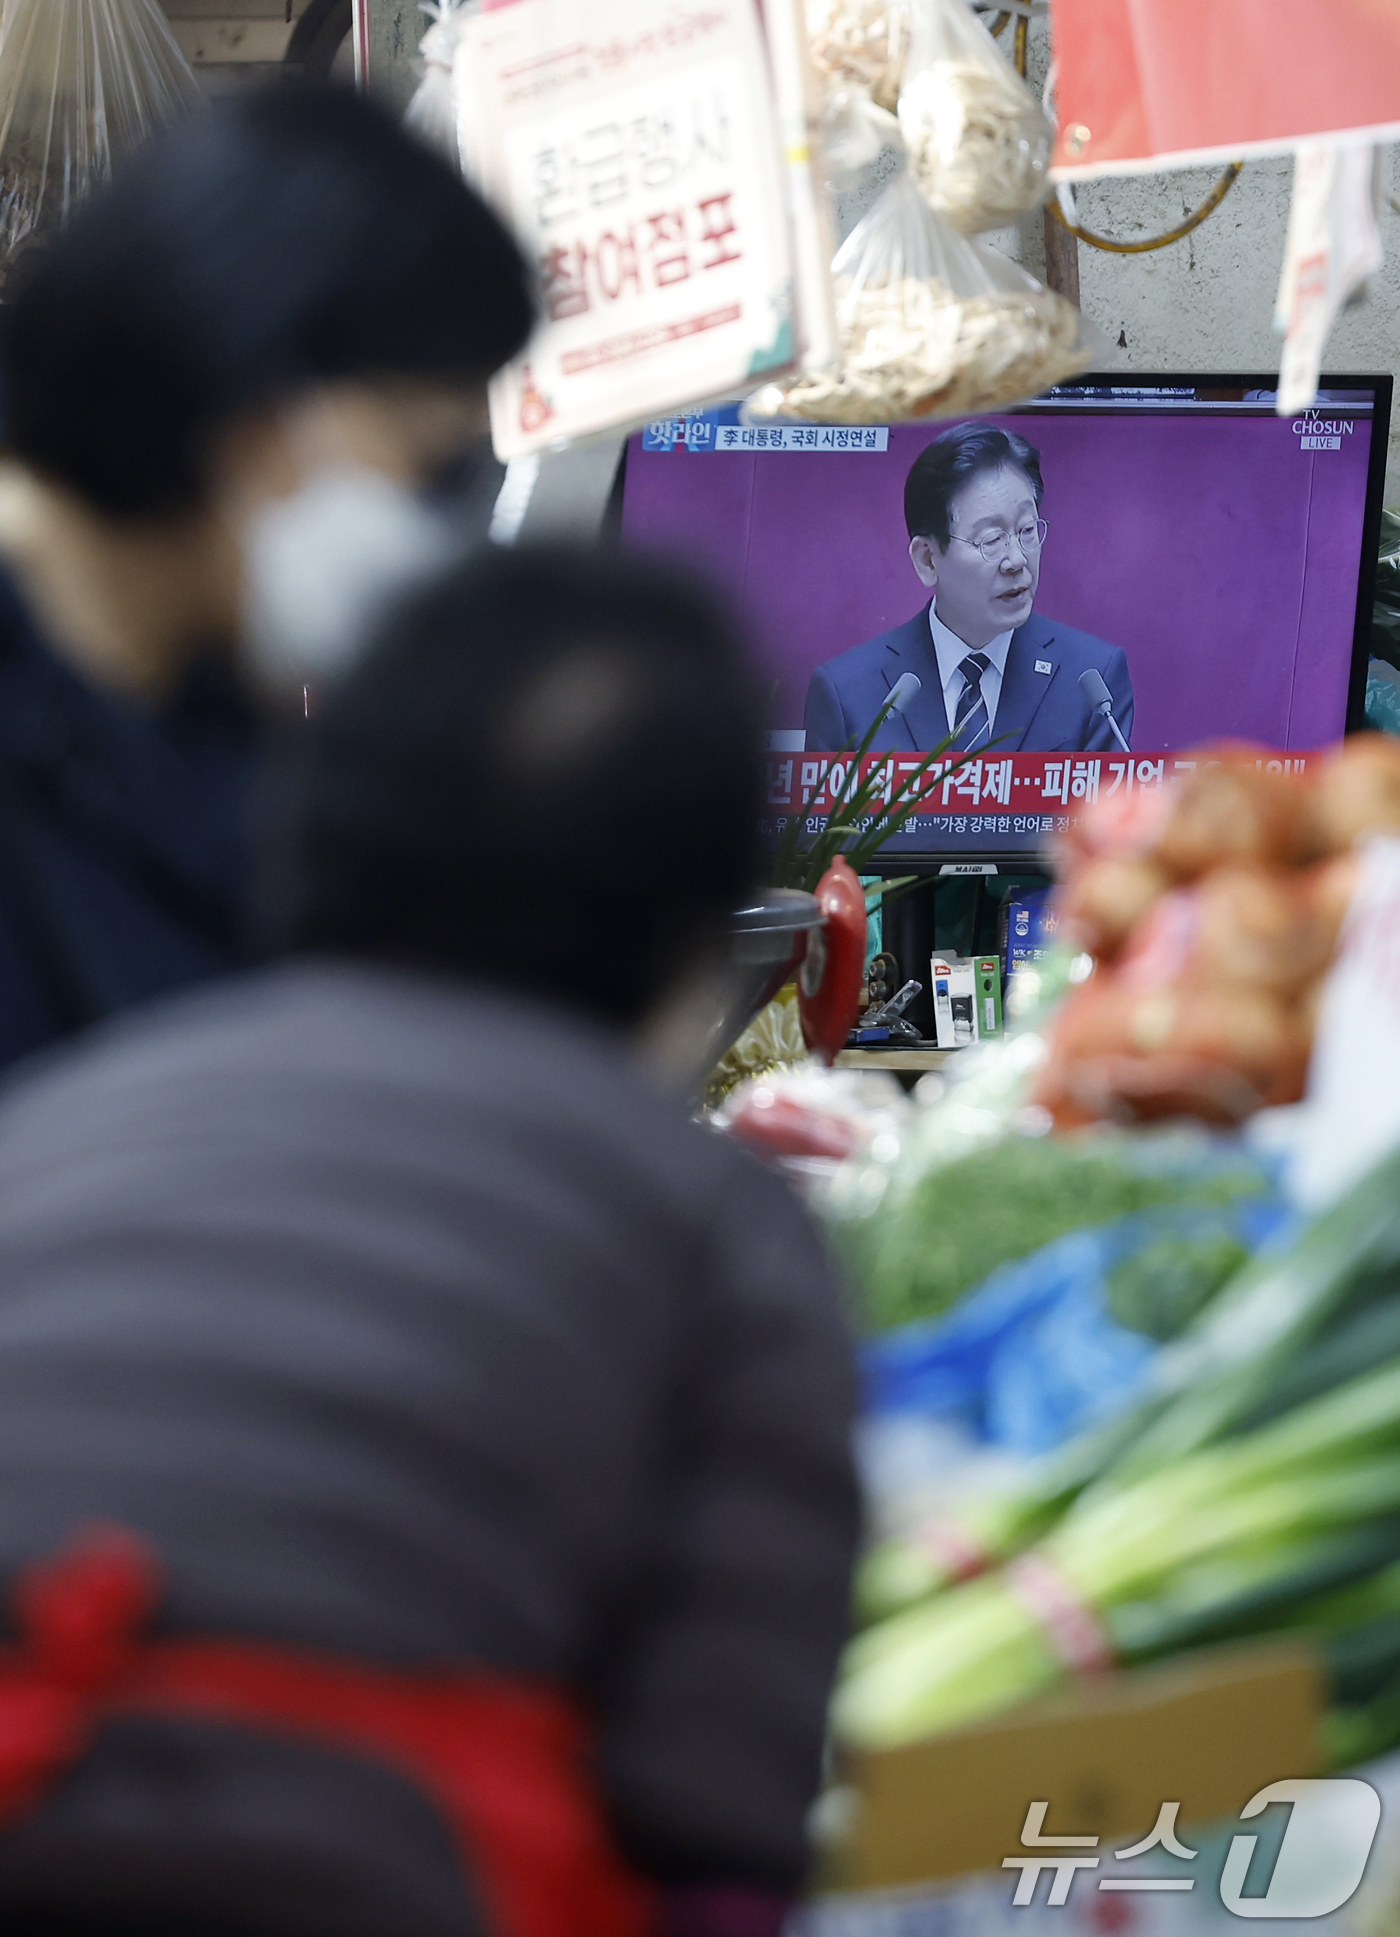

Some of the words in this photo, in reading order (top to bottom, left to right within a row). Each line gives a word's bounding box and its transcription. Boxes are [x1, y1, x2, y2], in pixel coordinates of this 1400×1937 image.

[1302, 410, 1321, 420] TV
[648, 420, 711, 445] 핫라인
[1291, 420, 1354, 435] CHOSUN
[724, 429, 738, 446] 李
[742, 429, 788, 448] 대통령,
[791, 429, 818, 447] 국회
[822, 430, 877, 448] 시정연설
[1308, 438, 1334, 449] LIVE
[970, 816, 1011, 833] 강력한
[1014, 816, 1053, 833] 언어로
